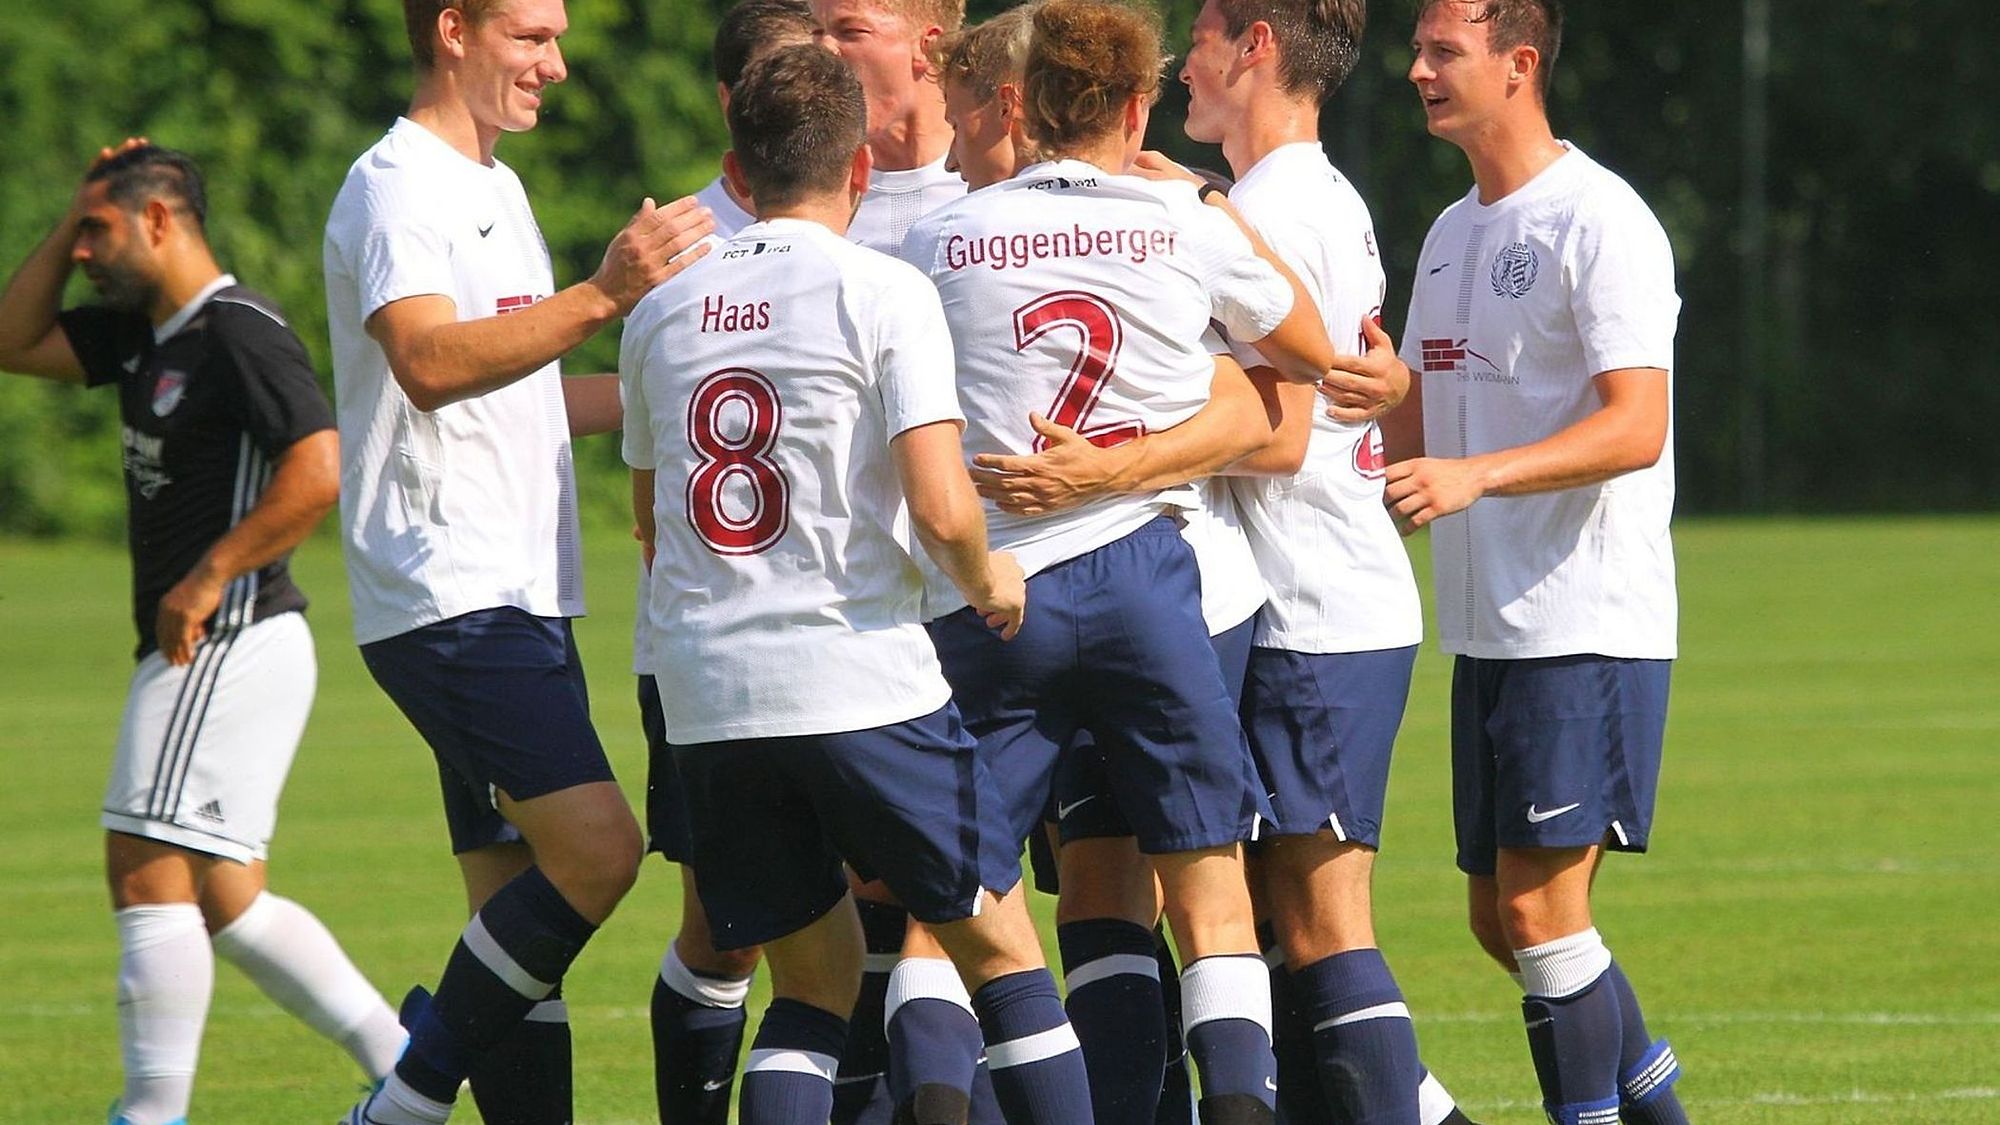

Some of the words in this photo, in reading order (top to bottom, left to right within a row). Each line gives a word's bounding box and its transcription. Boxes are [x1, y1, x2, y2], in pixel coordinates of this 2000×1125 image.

[946, 223, 1178, 271] Guggenberger
[701, 294, 771, 333] Haas
[1013, 290, 1145, 456] 2
[686, 367, 790, 556] 8
